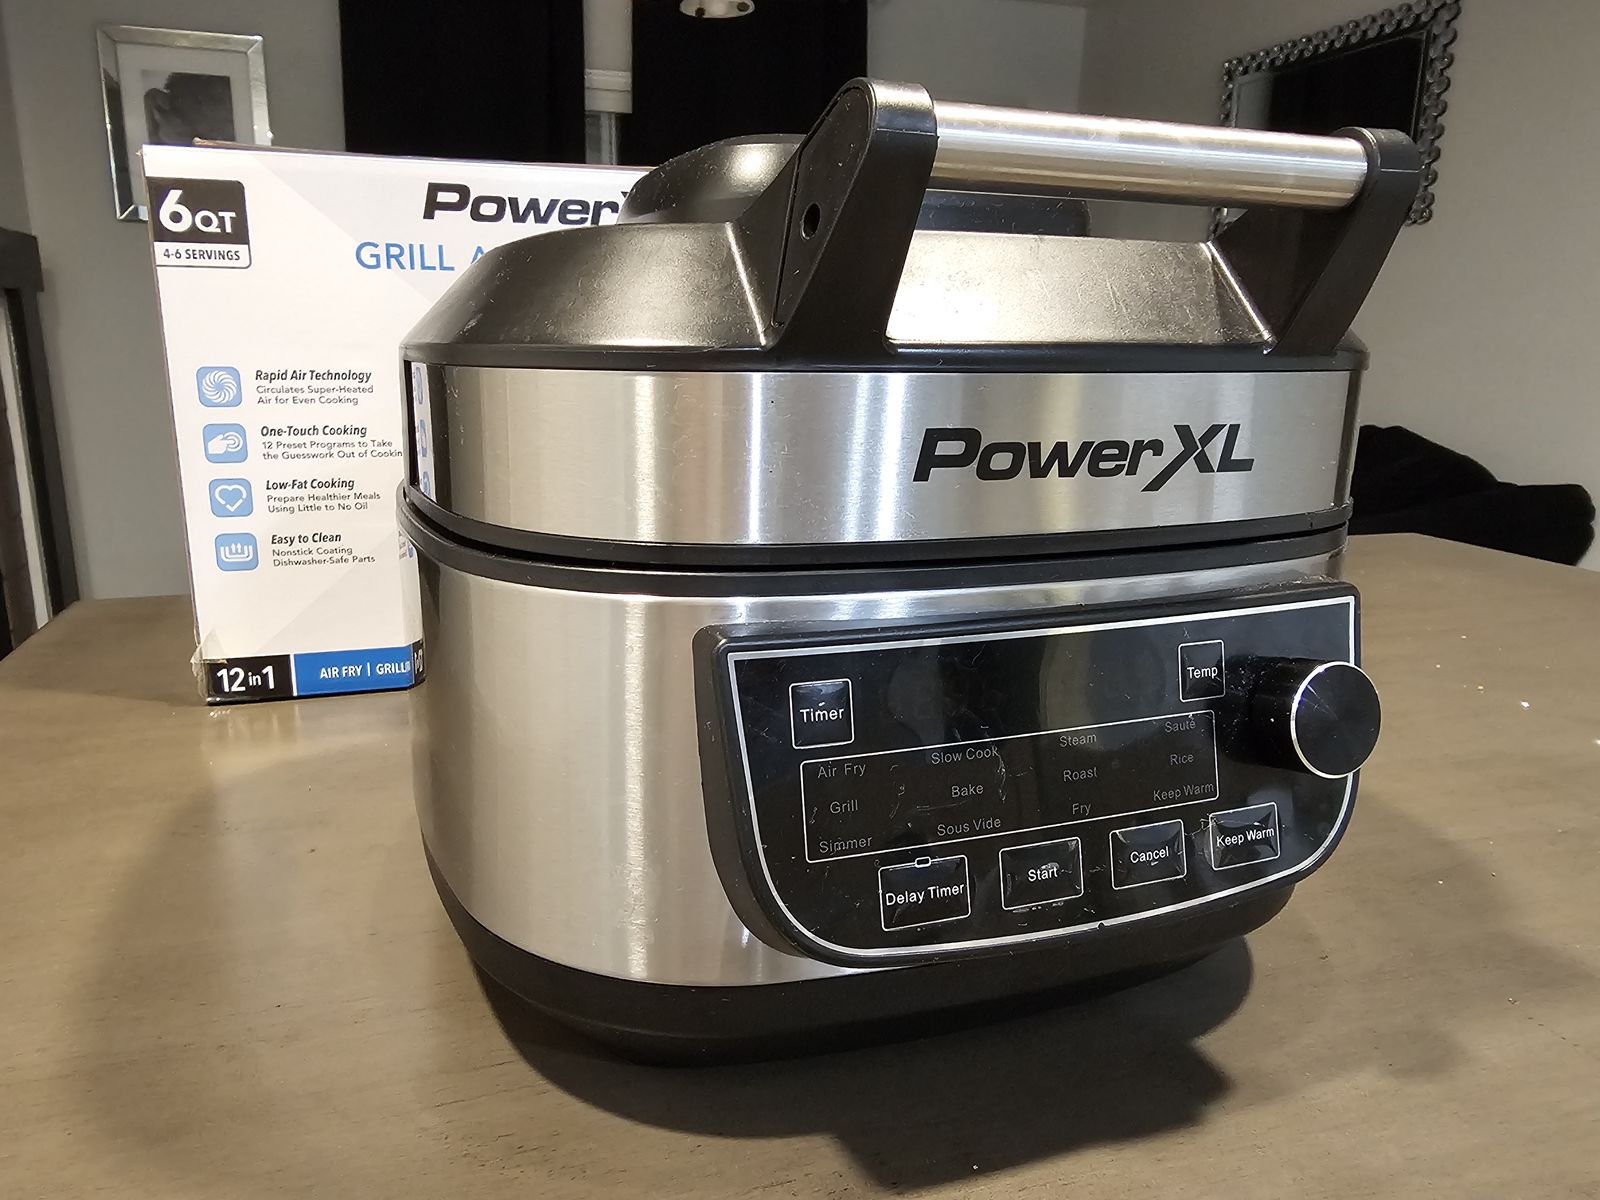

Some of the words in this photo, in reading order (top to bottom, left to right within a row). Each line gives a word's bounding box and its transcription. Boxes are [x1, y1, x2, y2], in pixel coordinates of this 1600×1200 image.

[423, 182, 630, 226] Power
[163, 248, 182, 259] 4-6
[185, 248, 240, 261] SERVINGS
[355, 241, 456, 272] GRILL
[255, 369, 287, 383] Rapid
[290, 369, 307, 381] Air
[309, 369, 372, 383] Technology
[256, 385, 305, 395] Circulates
[308, 384, 374, 395] Super-Heated
[257, 396, 273, 405] Air
[275, 396, 289, 404] for
[292, 396, 316, 404] Even
[318, 395, 359, 406] Cooking
[260, 425, 319, 437] One-Touch
[322, 424, 367, 438] Cooking
[262, 441, 273, 450] 12
[276, 440, 307, 450] Preset
[310, 440, 356, 452] Programs
[358, 440, 368, 448] to
[371, 439, 393, 448] Take
[262, 451, 279, 460] the
[281, 450, 334, 460] Guesswork
[337, 449, 355, 459] Out
[357, 449, 368, 458] of
[370, 448, 403, 458] Cookin
[912, 423, 1255, 493] PowerXL
[266, 478, 308, 491] Low-Fat
[310, 477, 355, 492] Cooking
[267, 494, 305, 504] Prepare
[308, 492, 351, 501] Healthier
[353, 491, 381, 500] Meals
[268, 505, 295, 515] Using
[297, 503, 322, 512] Little
[324, 503, 335, 512] to
[337, 502, 352, 511] No
[354, 501, 368, 511] Oil
[271, 533, 295, 547] Easy
[298, 533, 308, 543] to
[312, 532, 341, 543] Clean
[272, 547, 314, 557] Nonstick
[316, 546, 353, 557] Coating
[273, 556, 349, 567] Dishwasher-Safe
[352, 555, 376, 563] Parts
[319, 666, 340, 679] AIR
[342, 664, 362, 678] FRY
[1187, 666, 1218, 680] Temp
[800, 707, 844, 723] Timer
[1059, 733, 1097, 748] Steam
[931, 751, 962, 765] Slow
[965, 745, 1000, 760] Cook
[1170, 753, 1194, 765] Rice
[817, 766, 837, 779] Air
[844, 763, 867, 779] Fry
[1063, 767, 1098, 782] Roast
[951, 784, 984, 798] Bake
[1153, 789, 1182, 801] Keep
[1183, 783, 1214, 796] Warm
[829, 800, 859, 814] Grill
[1072, 802, 1092, 815] Fry
[937, 823, 970, 836] Sous
[973, 817, 1001, 831] Vide
[1216, 831, 1245, 848] Keep
[1246, 826, 1275, 842] Warm
[819, 836, 873, 854] Simmer
[1130, 846, 1170, 864] Cancel
[1027, 866, 1058, 883] Start
[885, 888, 925, 905] Delay
[928, 882, 965, 900] Timer
